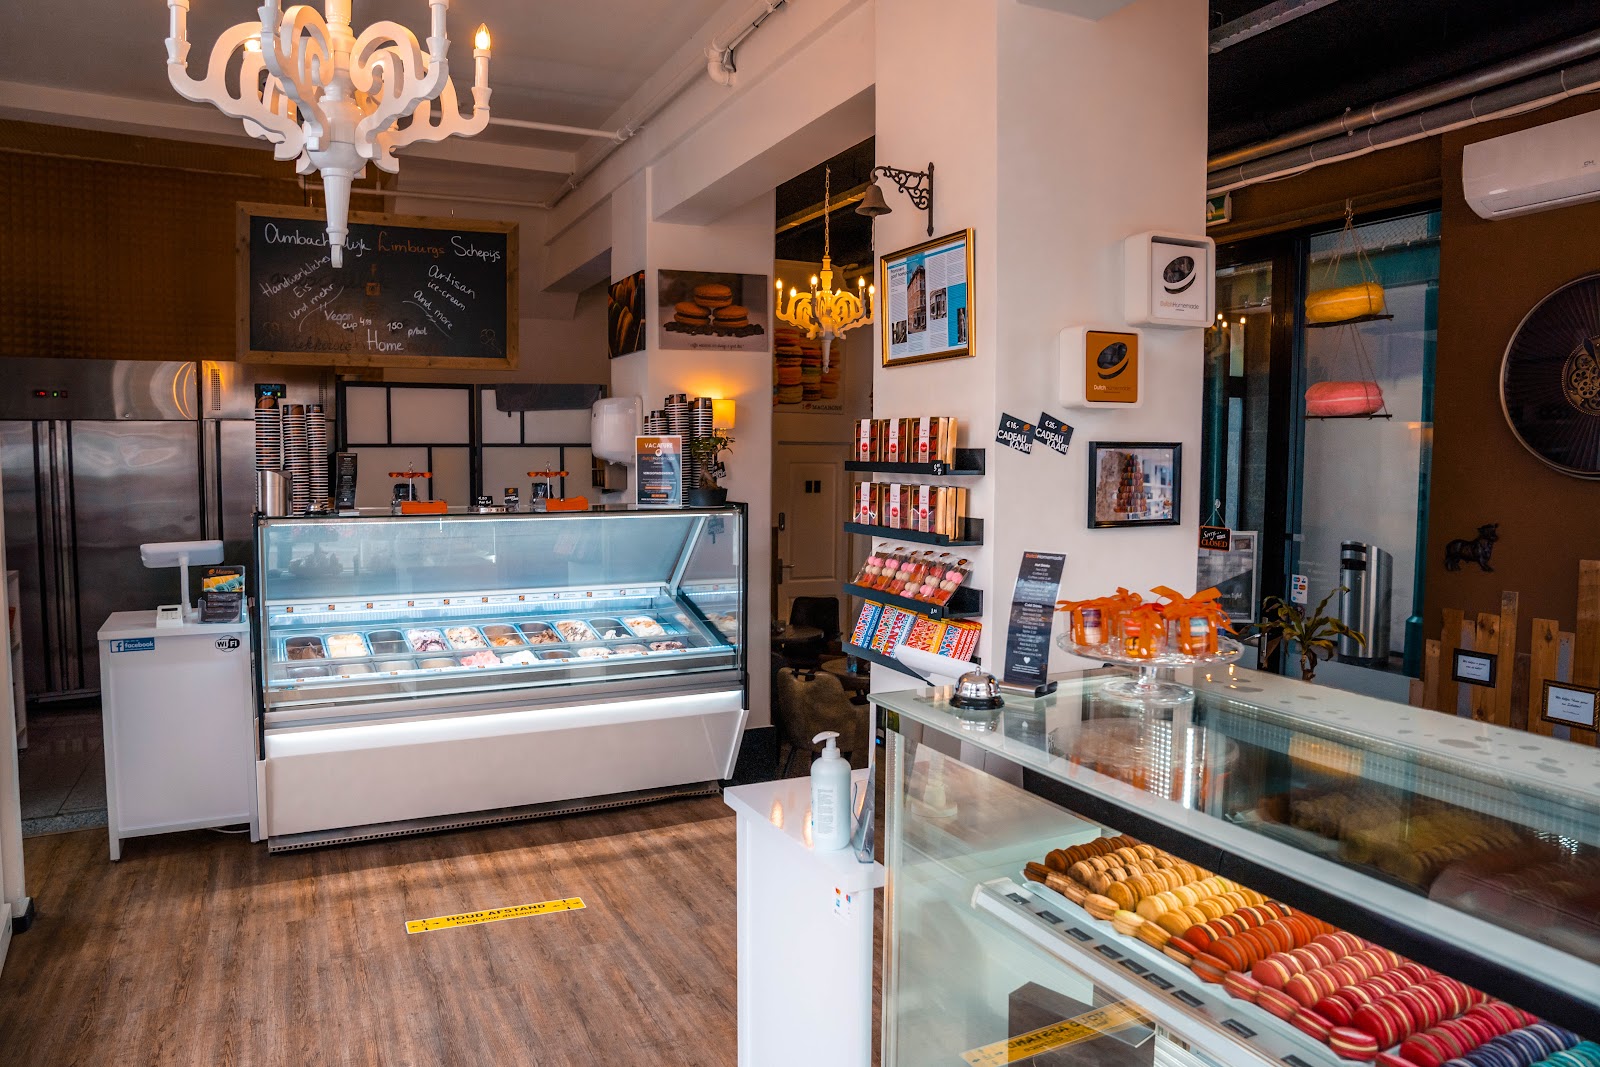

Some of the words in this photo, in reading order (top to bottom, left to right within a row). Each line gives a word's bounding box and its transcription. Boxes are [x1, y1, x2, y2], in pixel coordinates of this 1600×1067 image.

[264, 222, 371, 257] Ambachlijk
[378, 231, 446, 258] Limburgs
[451, 236, 501, 262] Schepijs
[428, 264, 476, 299] Artisan
[292, 283, 312, 298] Eis
[311, 283, 334, 304] mehr
[324, 310, 353, 325] Vegan
[413, 290, 432, 311] And
[434, 308, 453, 330] more
[342, 321, 358, 332] cup
[366, 328, 404, 352] Home
[997, 429, 1027, 444] CADEAU
[1035, 428, 1064, 444] CADEAU
[1009, 440, 1032, 453] KAART
[1046, 439, 1069, 453] KAART
[1201, 539, 1228, 547] CLOSED
[125, 641, 154, 649] facebook
[446, 912, 484, 922] HOUD
[489, 903, 545, 915] AFSTAND
